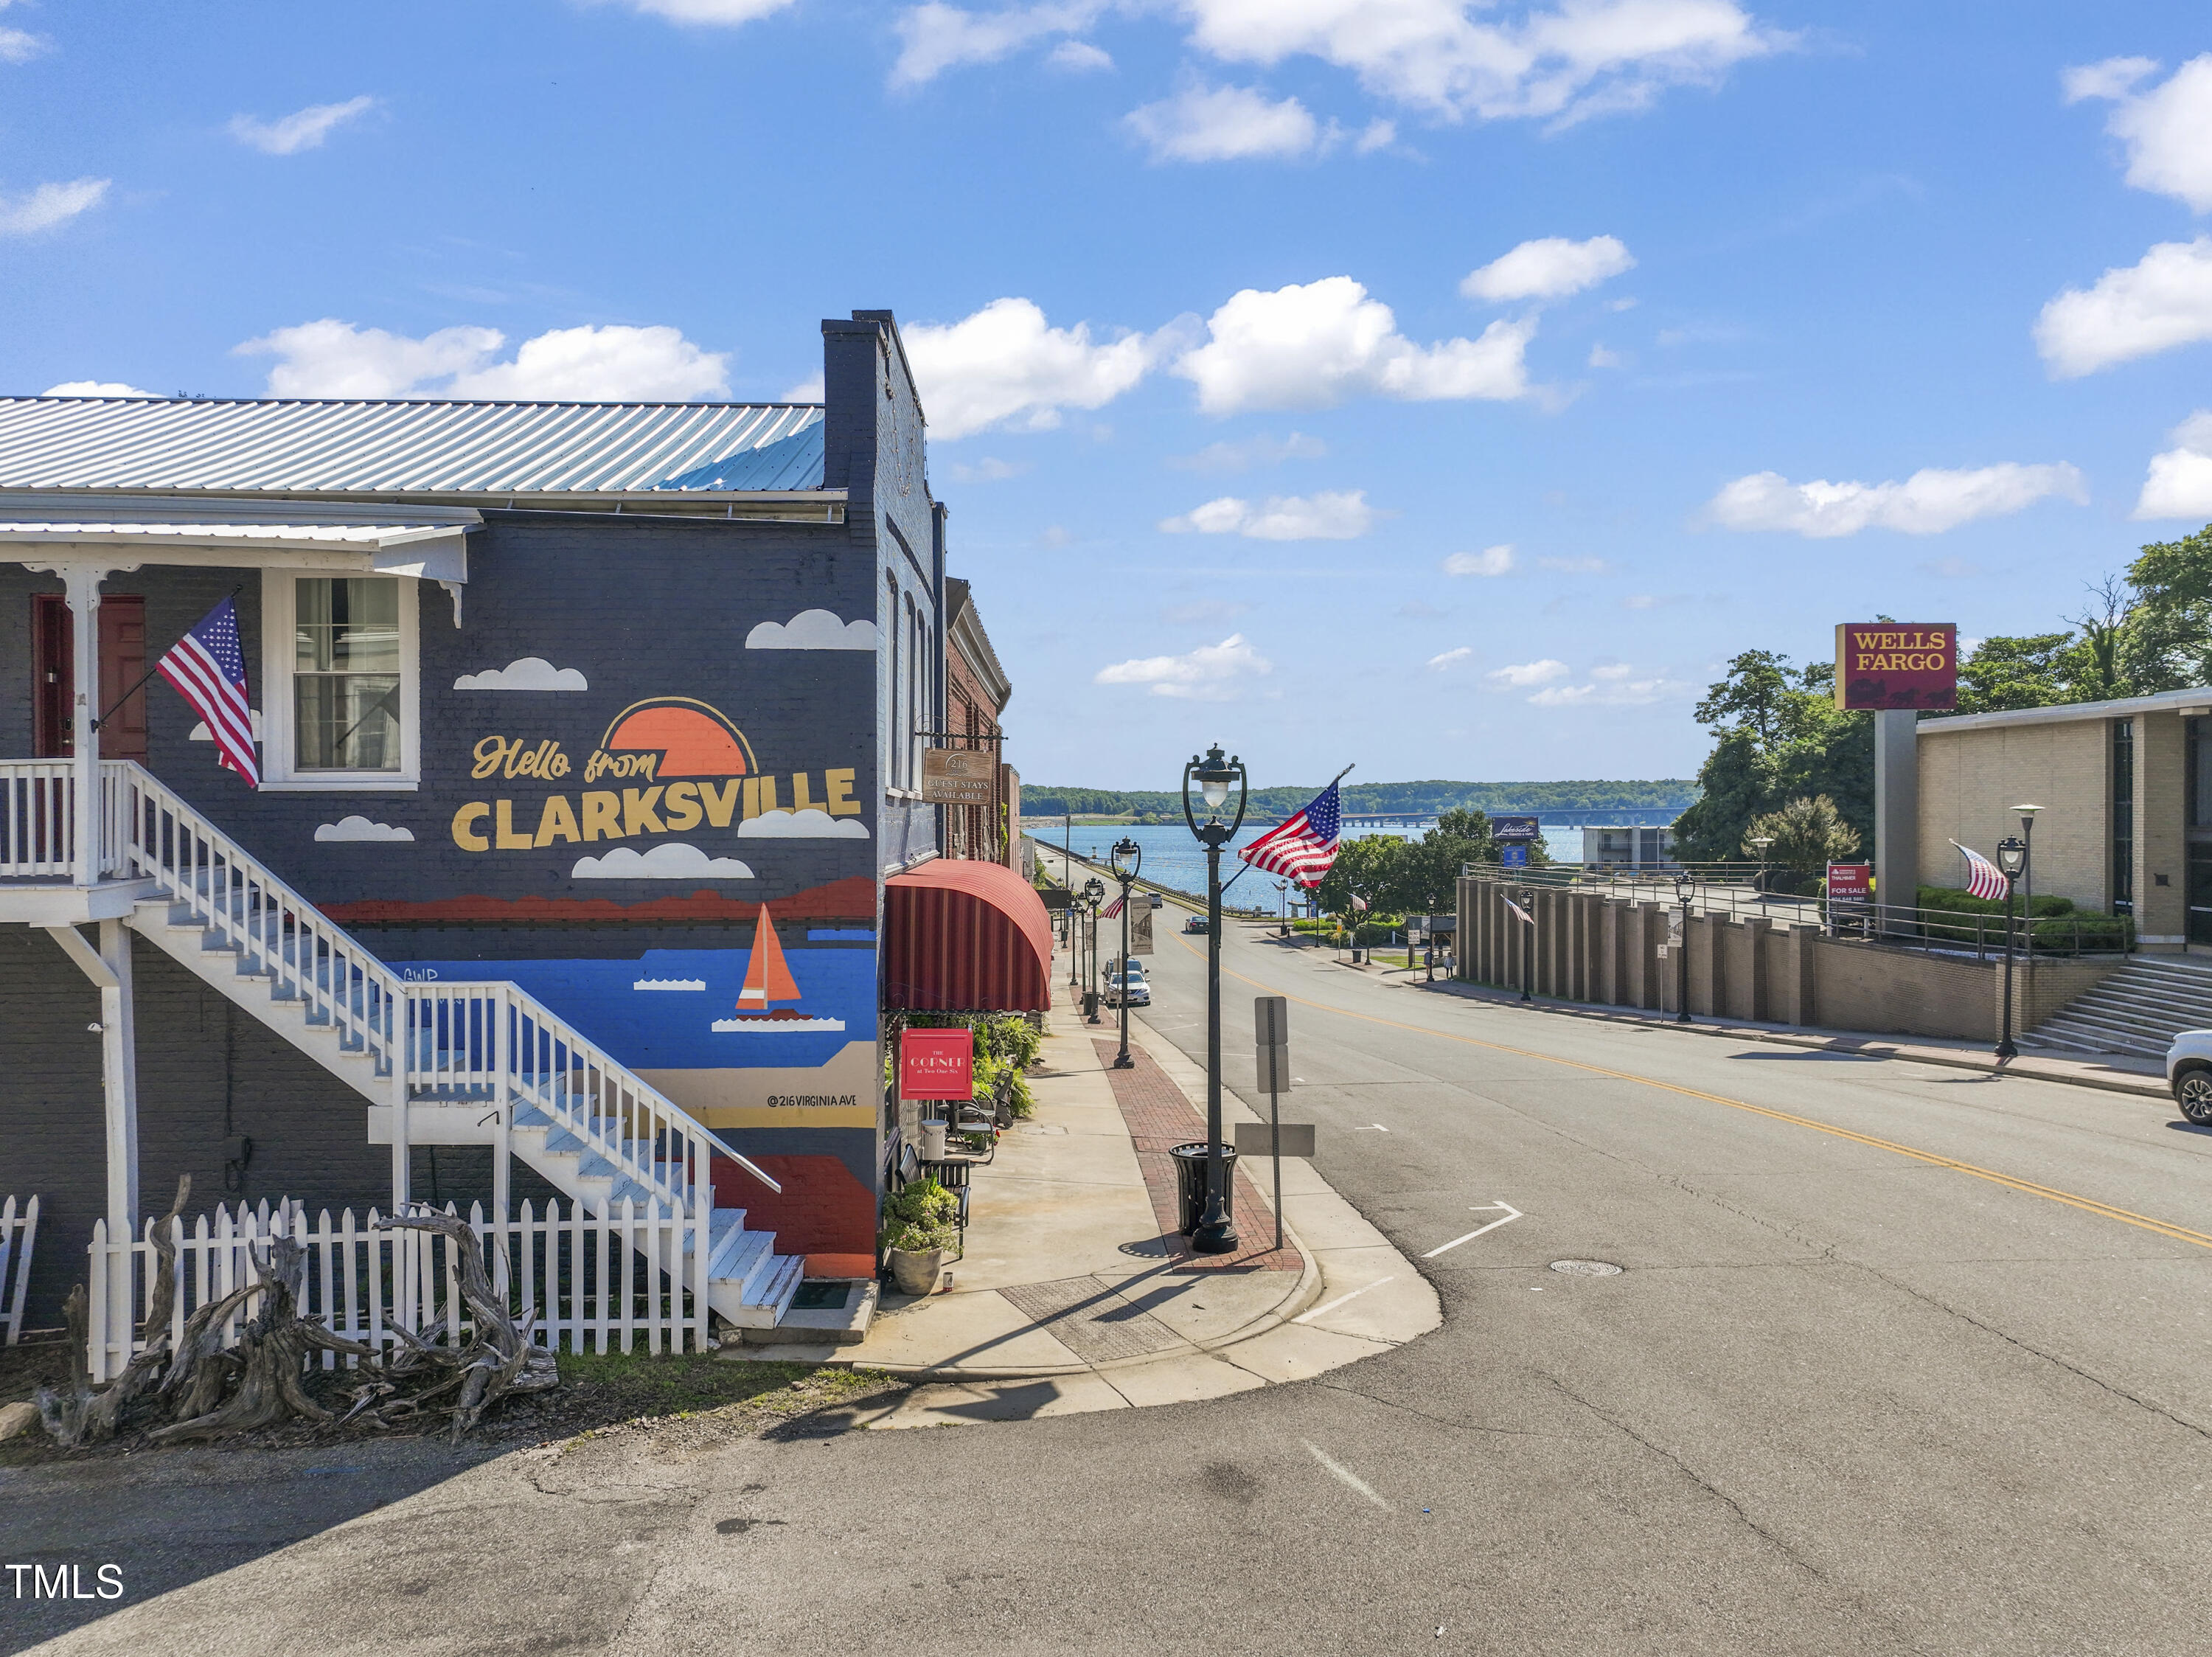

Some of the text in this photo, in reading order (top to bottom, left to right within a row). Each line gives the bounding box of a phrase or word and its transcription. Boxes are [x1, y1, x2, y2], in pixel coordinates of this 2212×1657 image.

[1854, 632, 1946, 650] WELLS
[1856, 653, 1945, 671] FARGO
[471, 735, 659, 783] Hello from
[950, 760, 968, 768] 216
[928, 779, 989, 789] GUEST STAYS
[931, 791, 984, 800] AVAILABLE
[451, 767, 861, 852] CLARKSVILLE
[1495, 823, 1532, 838] Lakeside
[910, 1057, 965, 1067] CORNER
[796, 1095, 838, 1107] VIRGINIA
[838, 1094, 857, 1106] AVE
